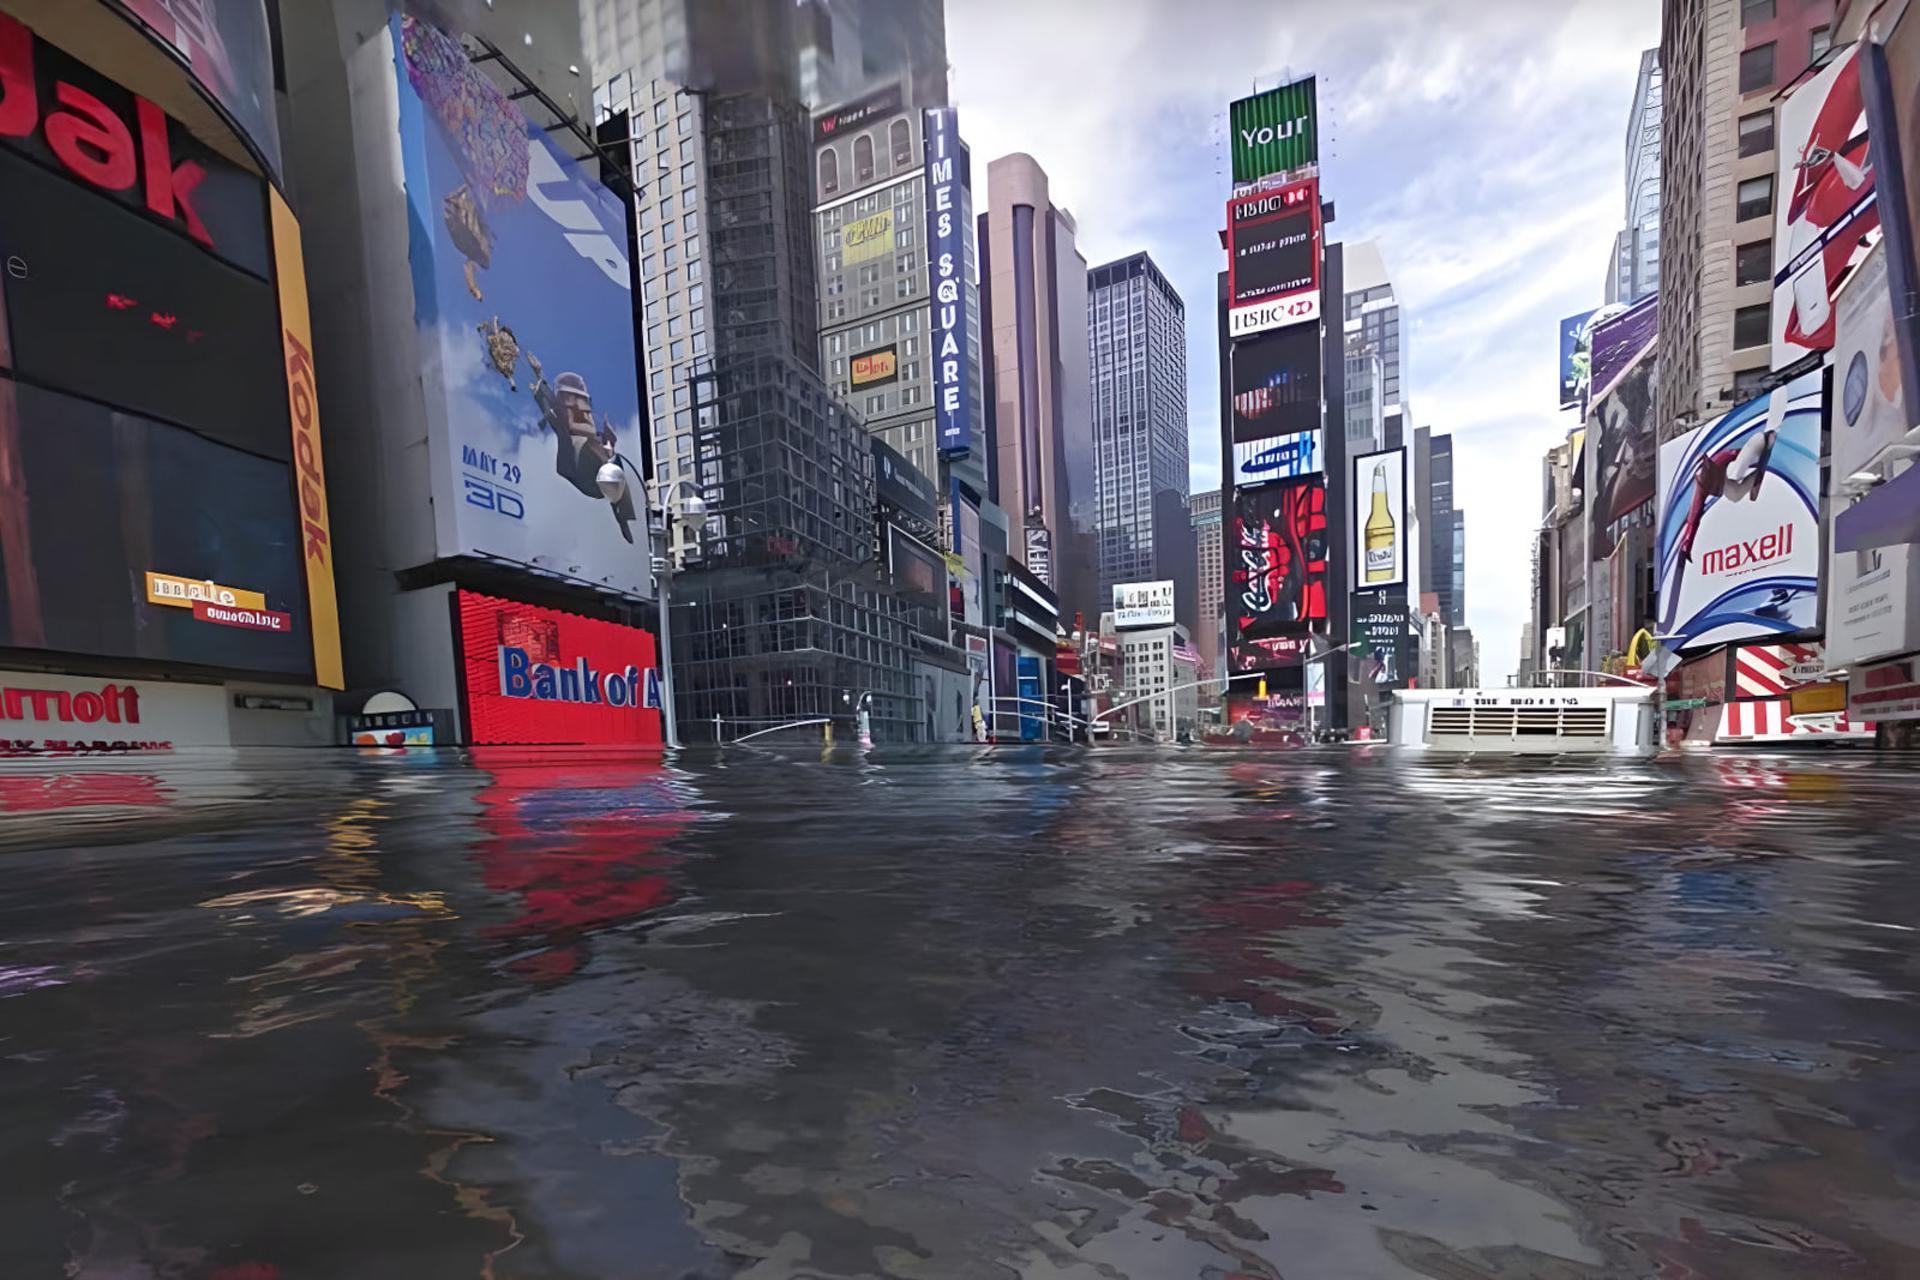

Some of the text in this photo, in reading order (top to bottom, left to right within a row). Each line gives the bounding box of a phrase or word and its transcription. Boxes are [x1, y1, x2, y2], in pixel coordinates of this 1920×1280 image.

[927, 109, 953, 238] TIMES
[937, 253, 960, 412] SQUARE
[285, 328, 328, 565] Kodak
[502, 462, 521, 484] 29
[464, 479, 524, 519] 3D
[1701, 523, 1793, 575] maxell
[498, 645, 603, 704] Bank
[604, 665, 638, 708] of
